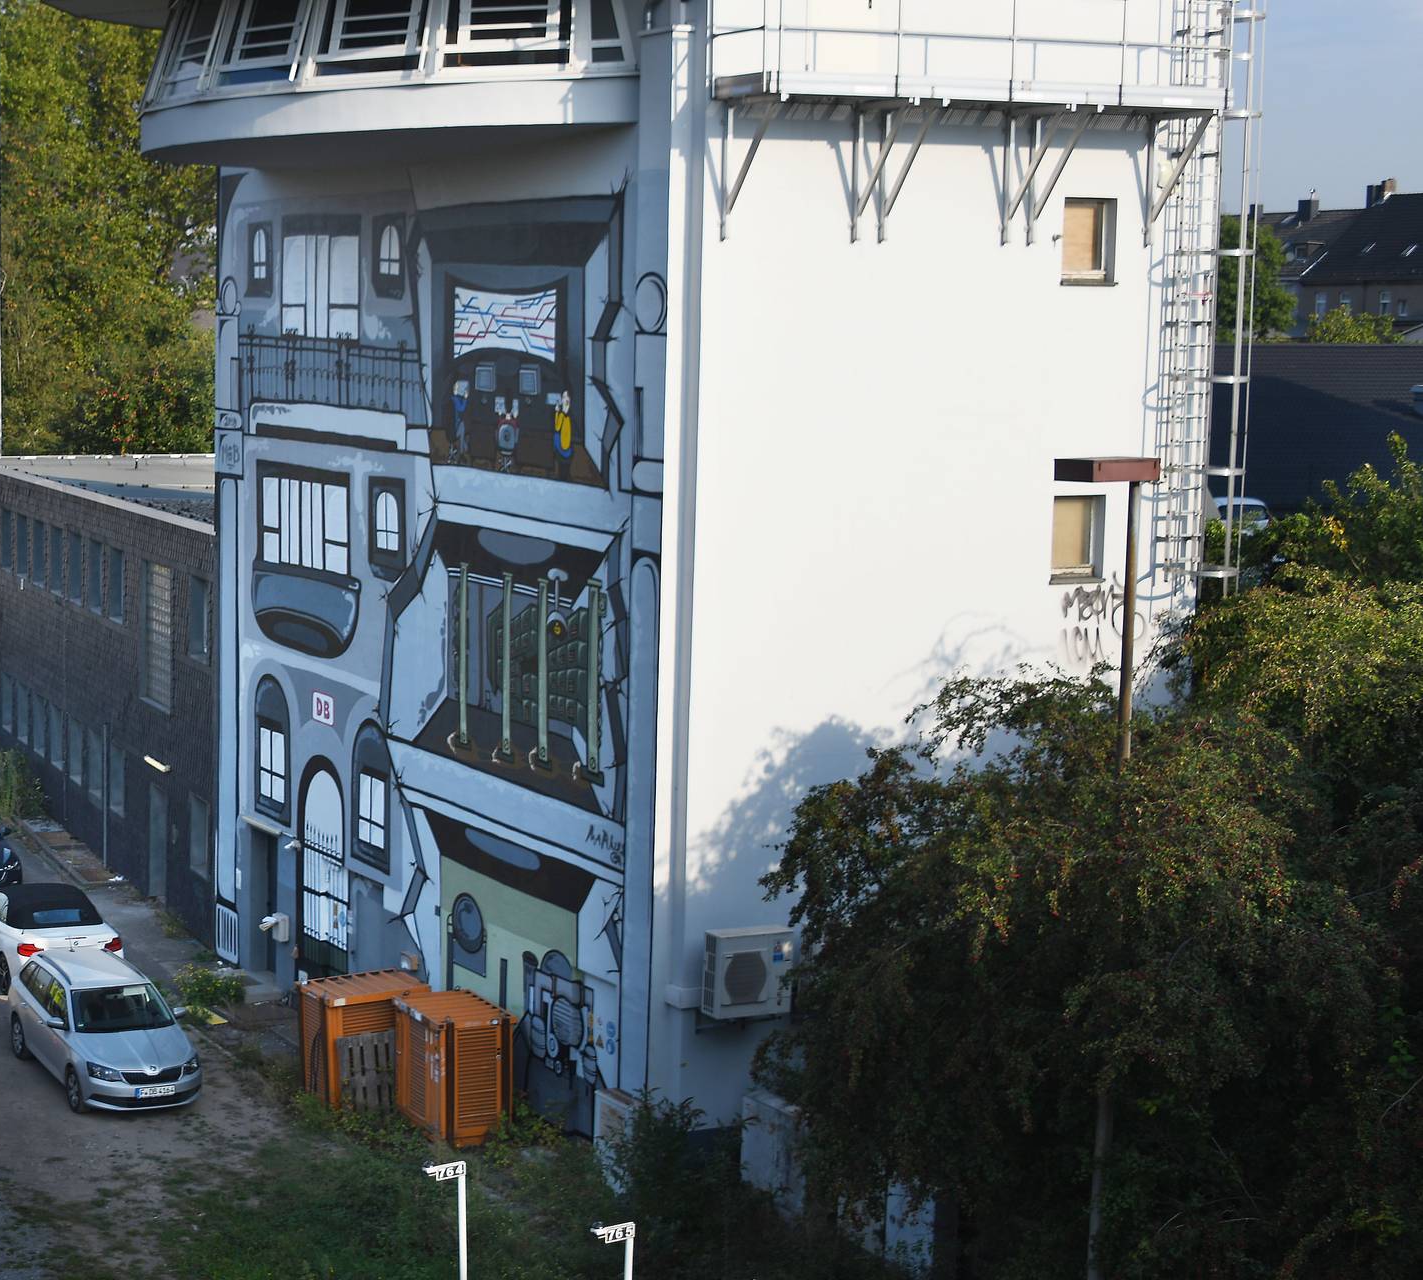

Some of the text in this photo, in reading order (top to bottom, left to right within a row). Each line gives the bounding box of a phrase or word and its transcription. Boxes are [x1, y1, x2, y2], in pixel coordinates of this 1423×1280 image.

[316, 696, 330, 720] DB
[438, 1164, 464, 1179] 764
[607, 1225, 634, 1241] 765
